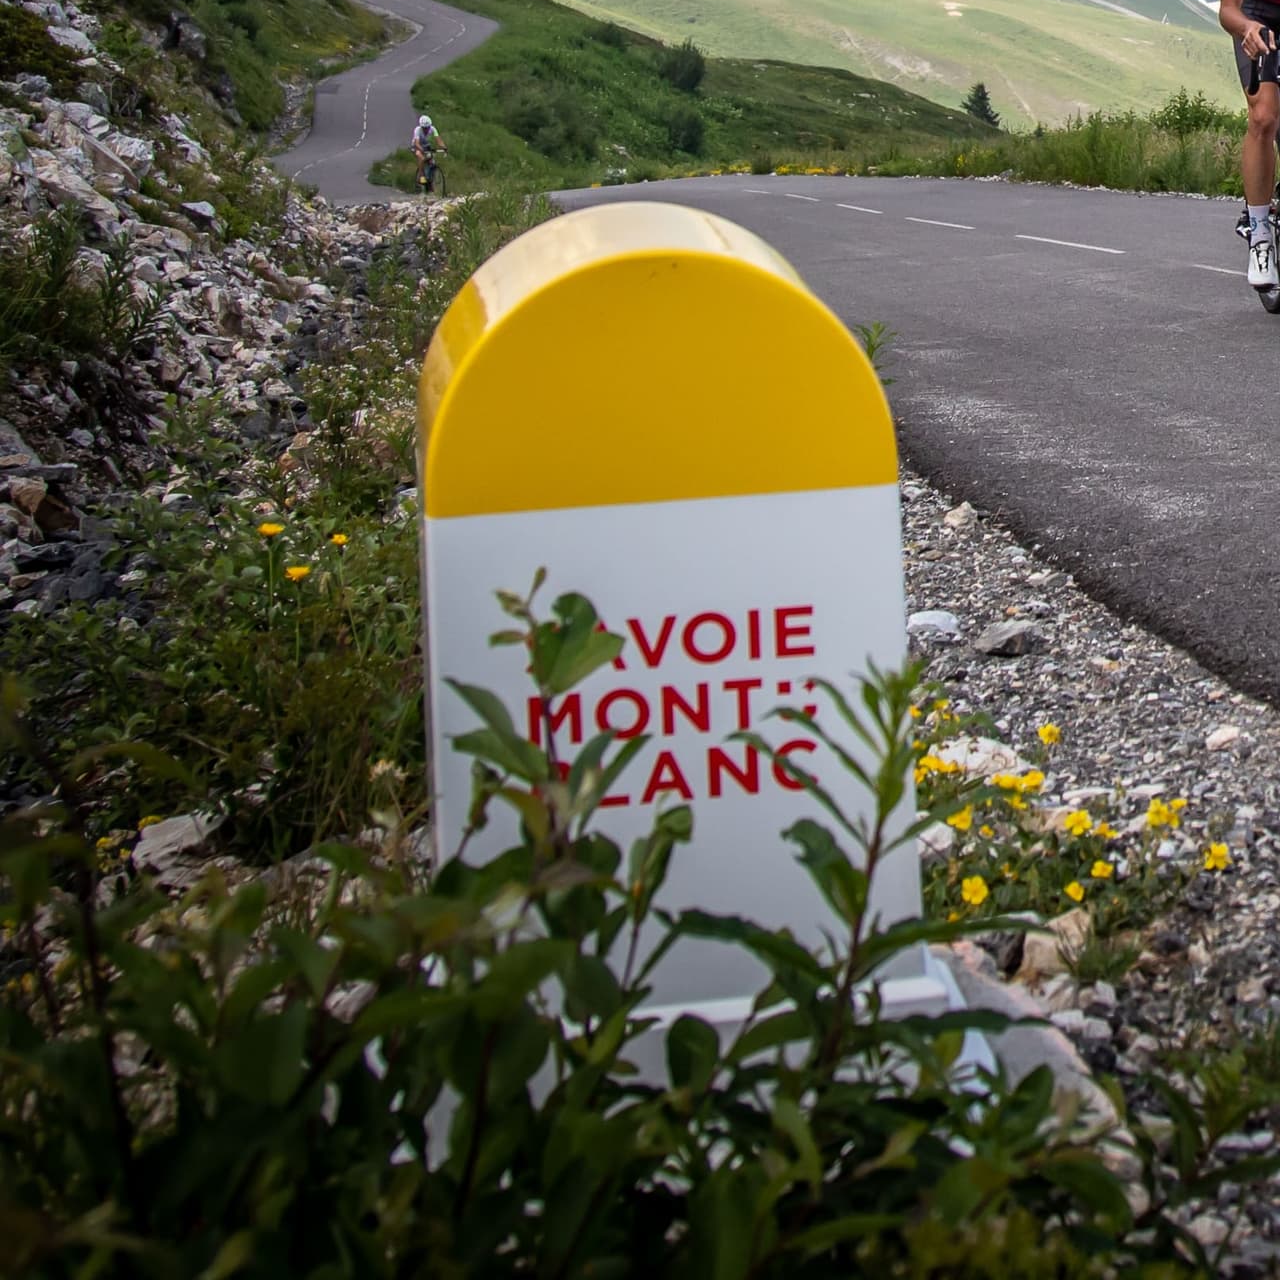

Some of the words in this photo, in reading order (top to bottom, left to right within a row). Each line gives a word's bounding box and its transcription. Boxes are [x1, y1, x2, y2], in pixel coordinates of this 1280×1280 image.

[526, 605, 815, 673] VOIE
[528, 678, 762, 745] MONT
[530, 739, 818, 808] ANC
